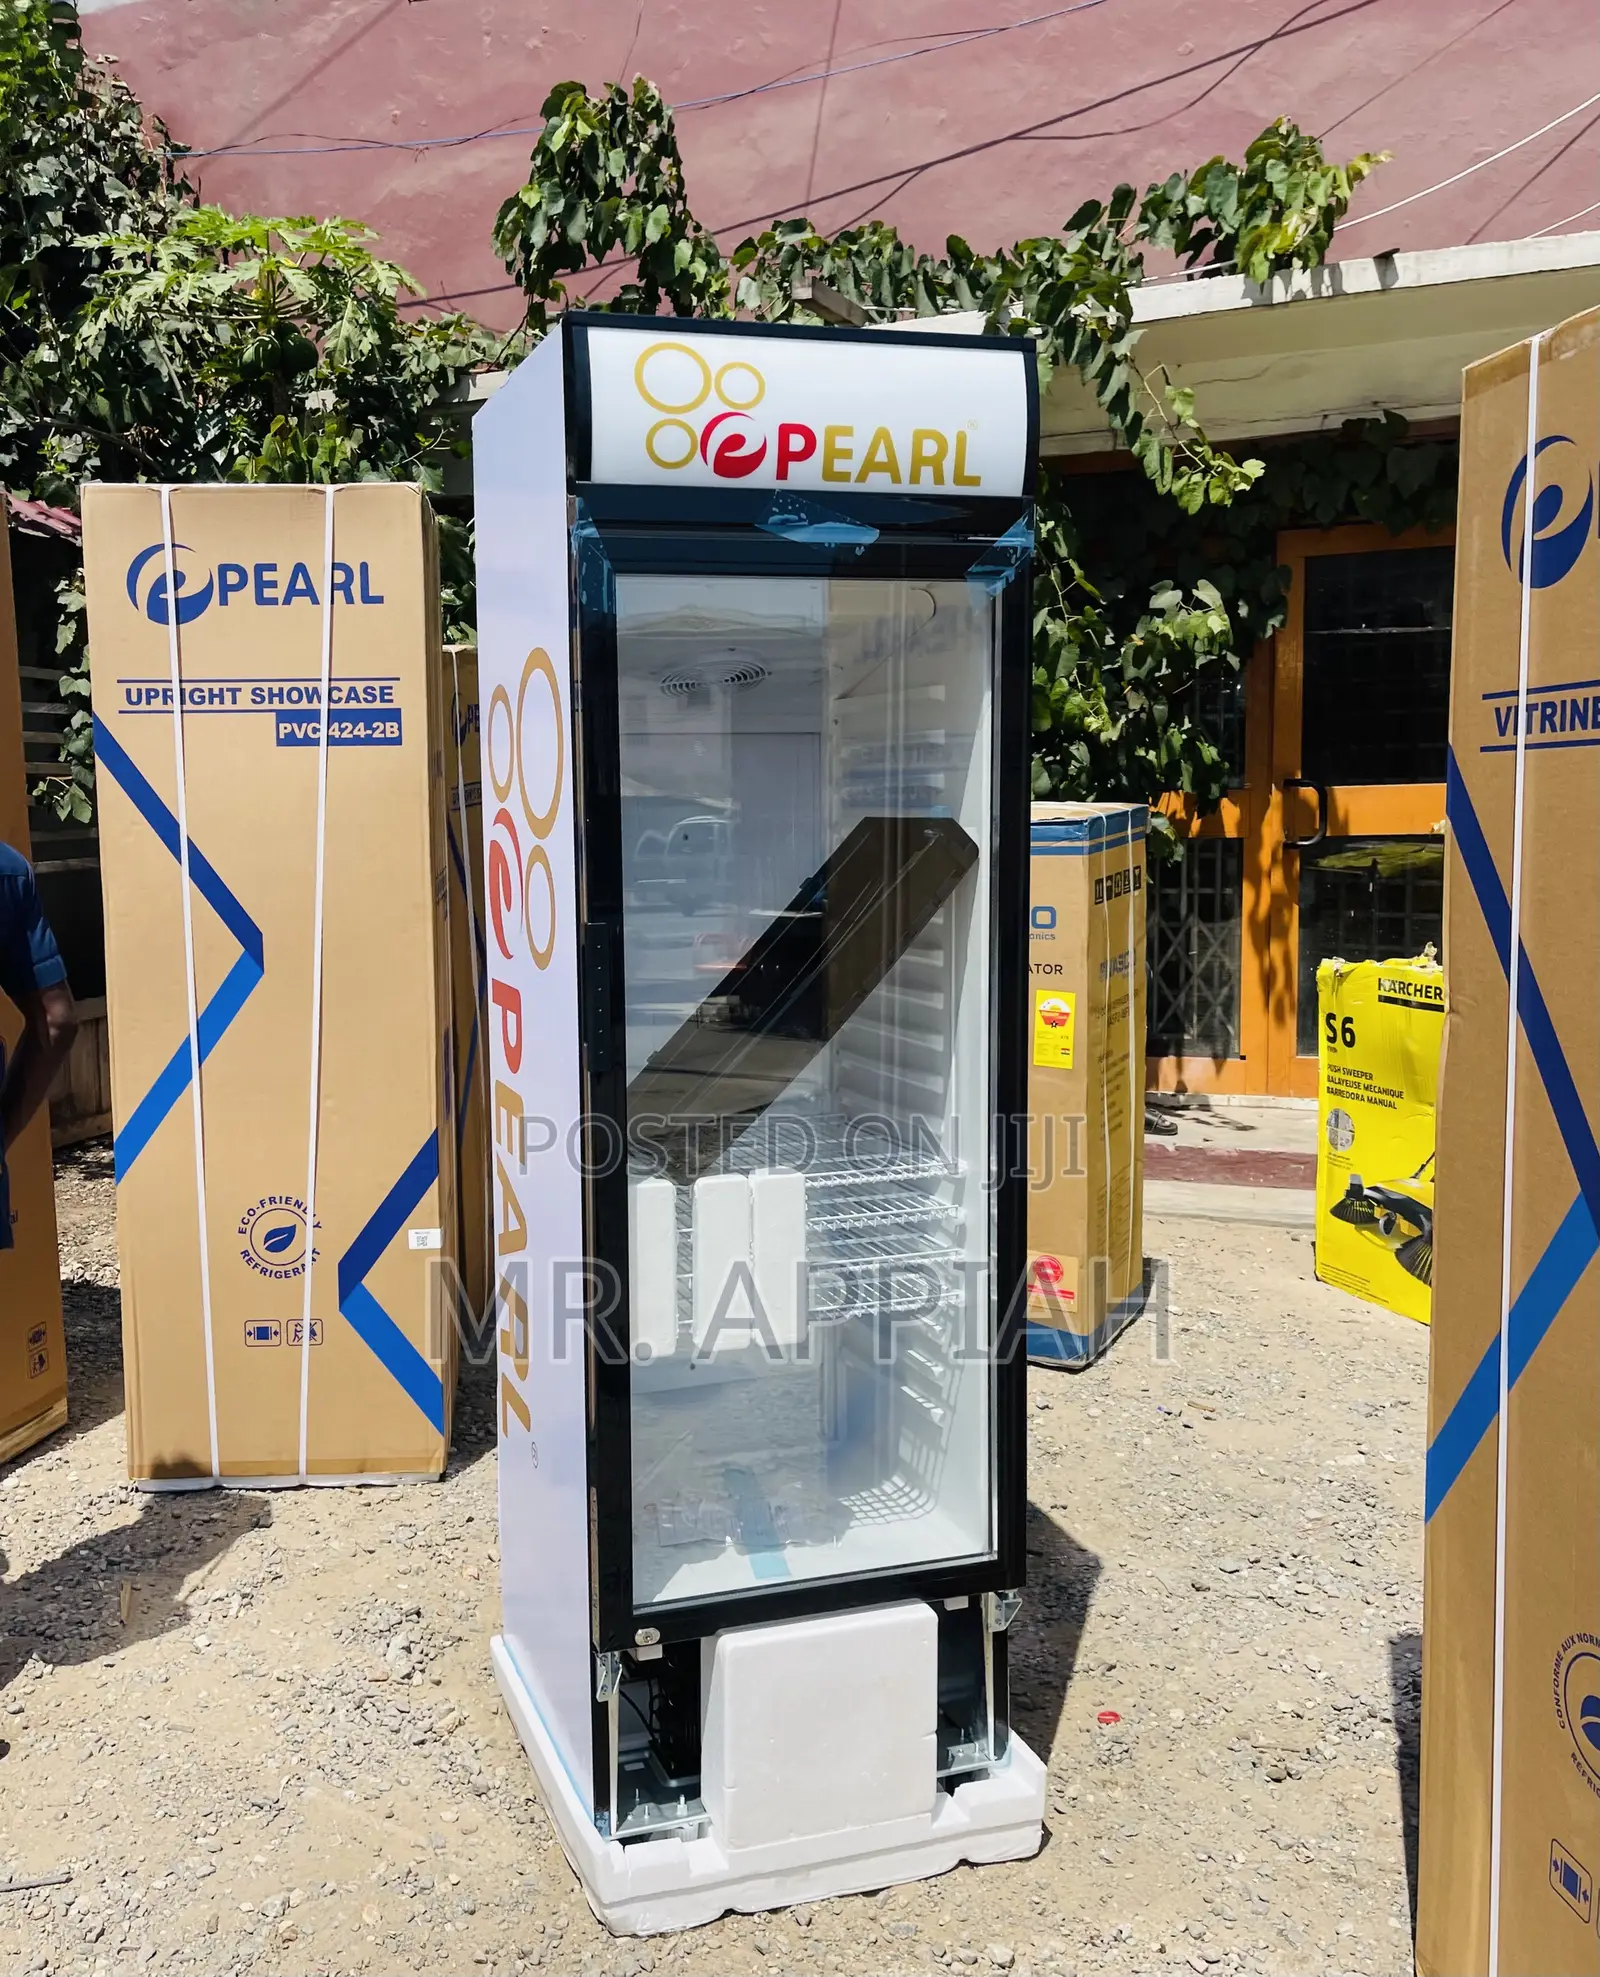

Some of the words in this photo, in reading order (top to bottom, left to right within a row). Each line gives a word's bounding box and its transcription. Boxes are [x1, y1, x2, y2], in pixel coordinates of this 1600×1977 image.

[775, 422, 982, 487] PEARL
[217, 561, 385, 606] PEARL
[125, 686, 242, 706] UPRIGHT
[250, 684, 394, 705] SHOWCASE
[1494, 695, 1600, 737] VITRINE
[1342, 1067, 1374, 1081] SWEEPER
[1366, 1095, 1398, 1110] MANUAL
[237, 1195, 323, 1235] ECO-FRIENY
[491, 977, 532, 1439] PEARL
[1562, 1635, 1577, 1654] AUX
